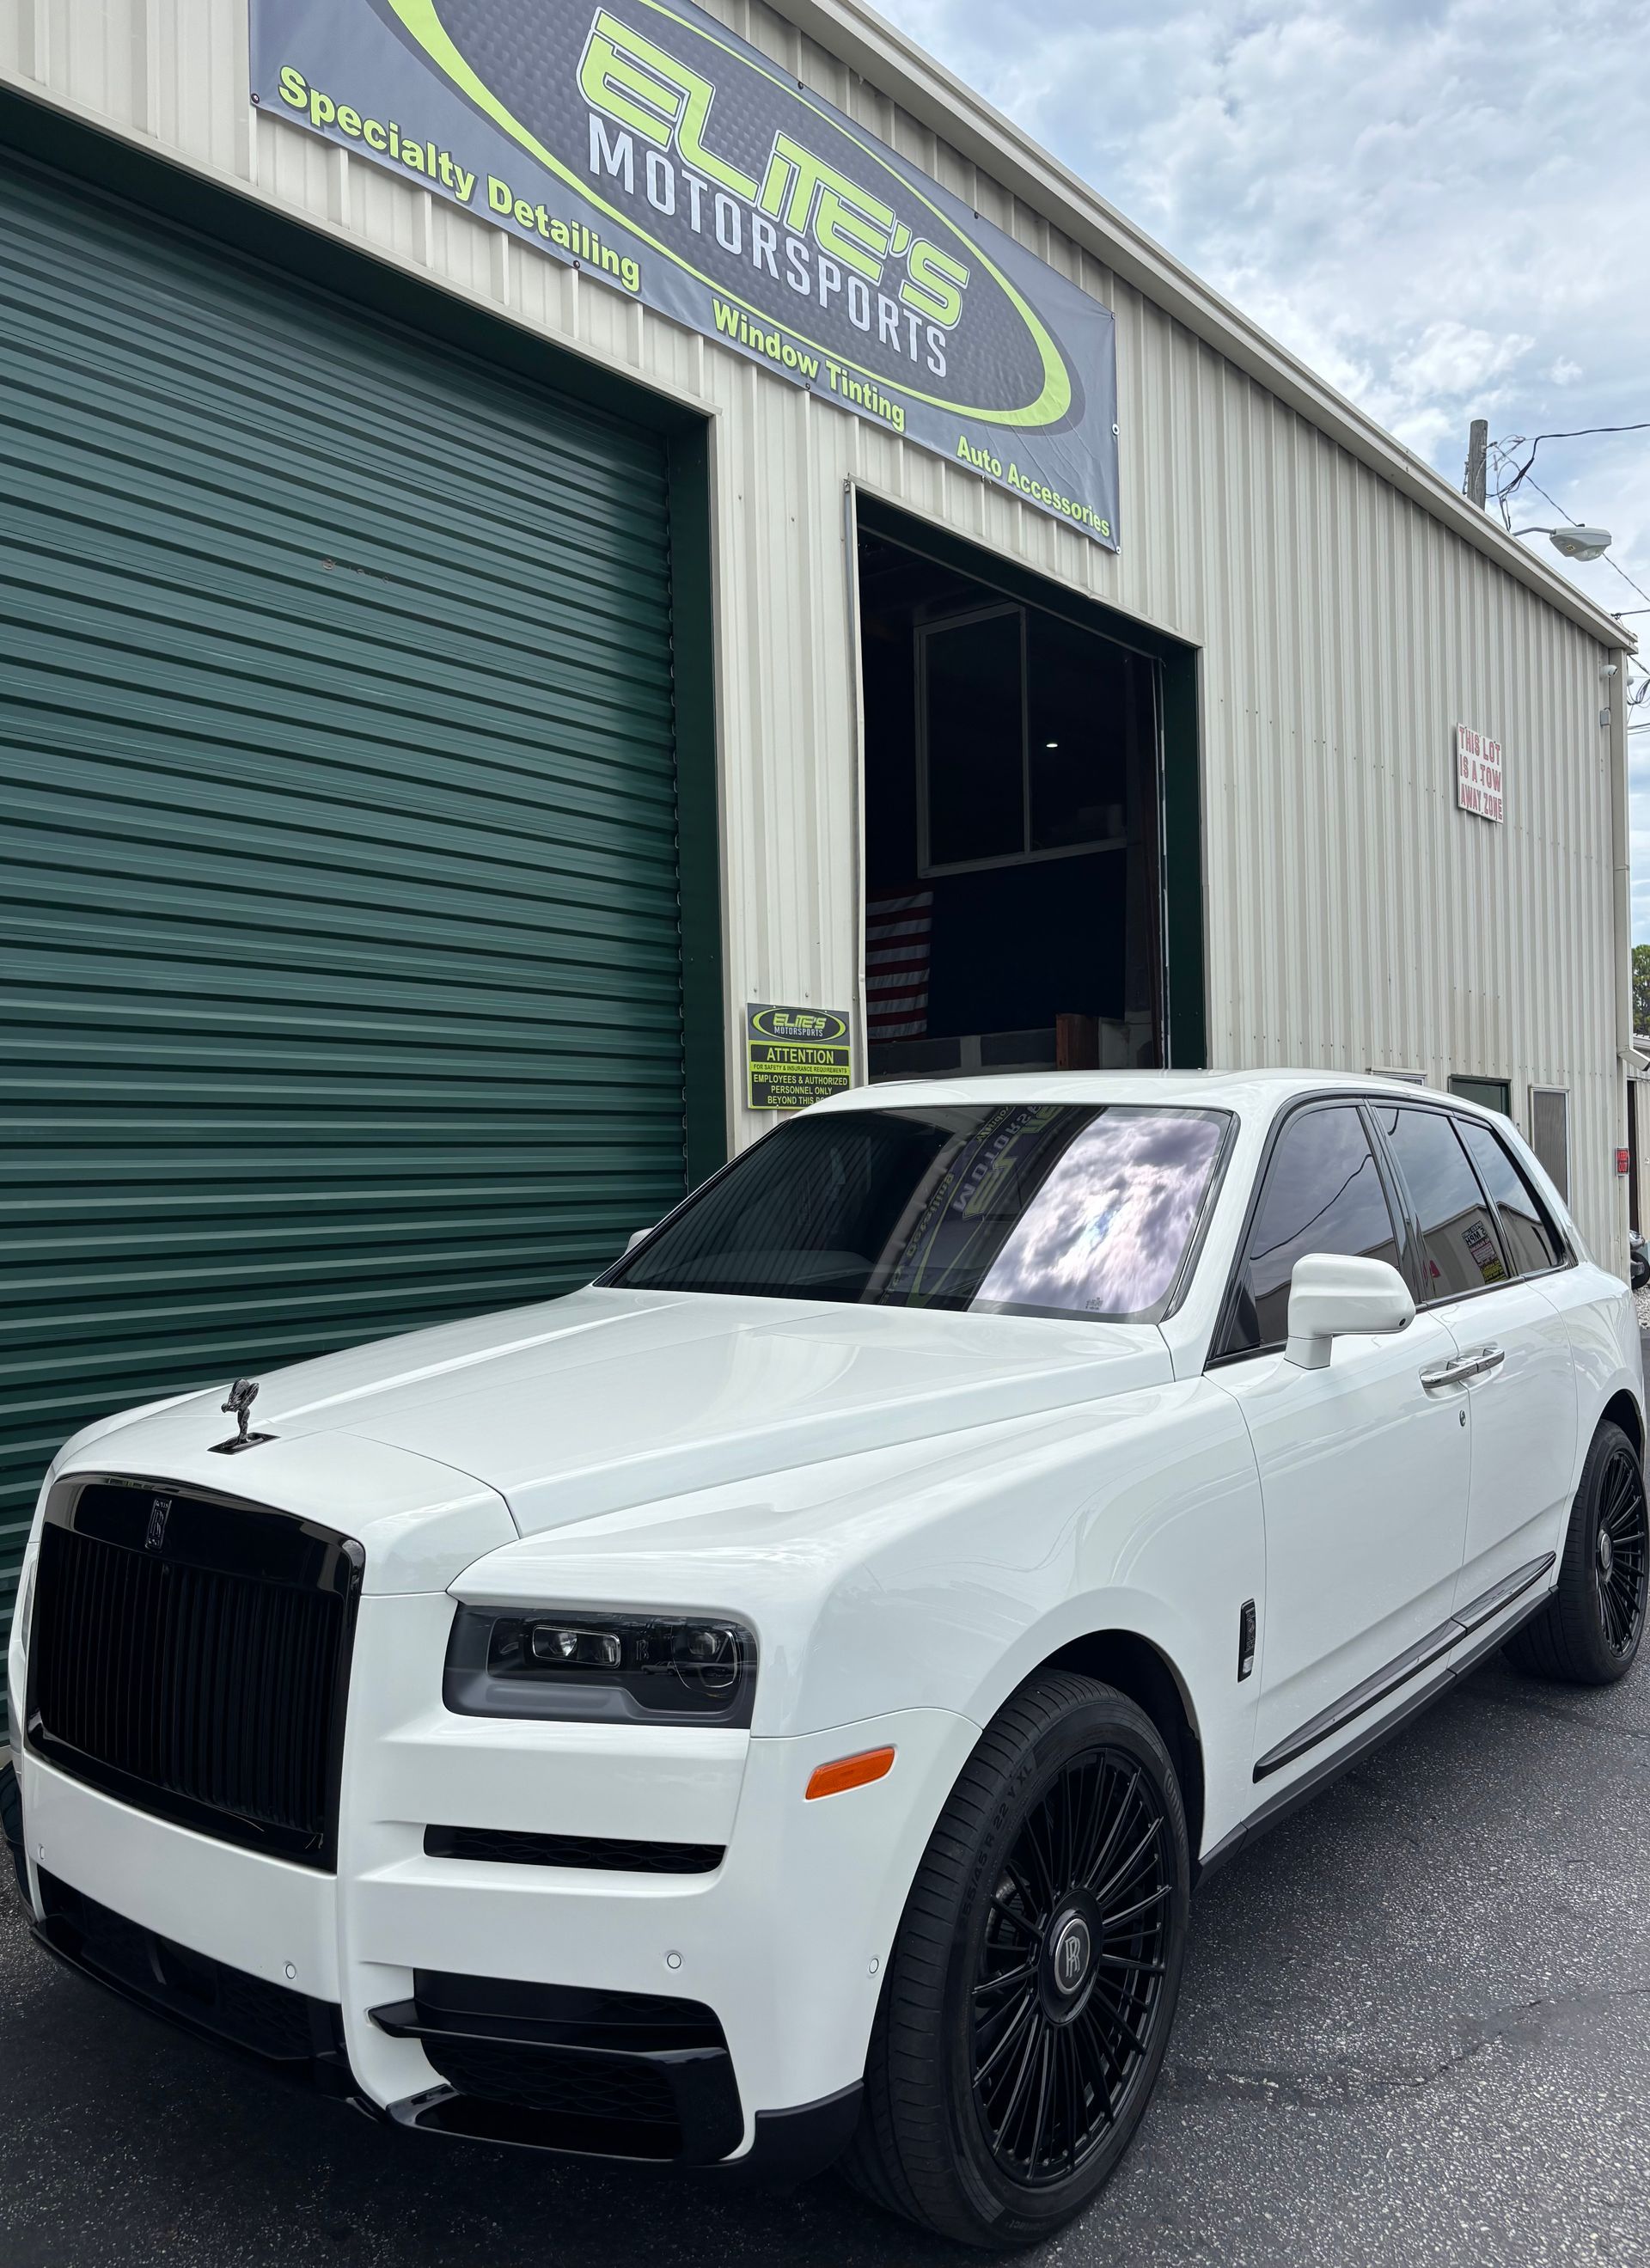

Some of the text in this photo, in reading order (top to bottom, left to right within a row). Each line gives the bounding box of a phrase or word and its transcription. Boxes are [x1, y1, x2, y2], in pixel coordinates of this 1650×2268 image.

[278, 65, 640, 292] Specialty Detailing
[577, 6, 969, 330] ELITE'S
[589, 112, 947, 378] MOTORSPORTS
[712, 298, 906, 432] Window Tinting
[956, 434, 1111, 537] Auto Accessories
[1459, 726, 1500, 766] THIS LOT
[1460, 754, 1501, 792] IS A TOW
[1461, 783, 1502, 821] AWAY ZONE
[773, 1012, 827, 1030] ELITE'S
[774, 1026, 823, 1036] MOTORSPORTS
[767, 1047, 834, 1065] ATTENTION
[754, 1074, 797, 1084] EMPLOYEES
[804, 1076, 848, 1085] AUTHORIZED
[771, 1085, 833, 1095] PERSONNEL ONLY
[767, 1096, 798, 1104] BEYOND
[798, 1096, 815, 1104] THIS
[993, 1802, 1010, 1831] 22
